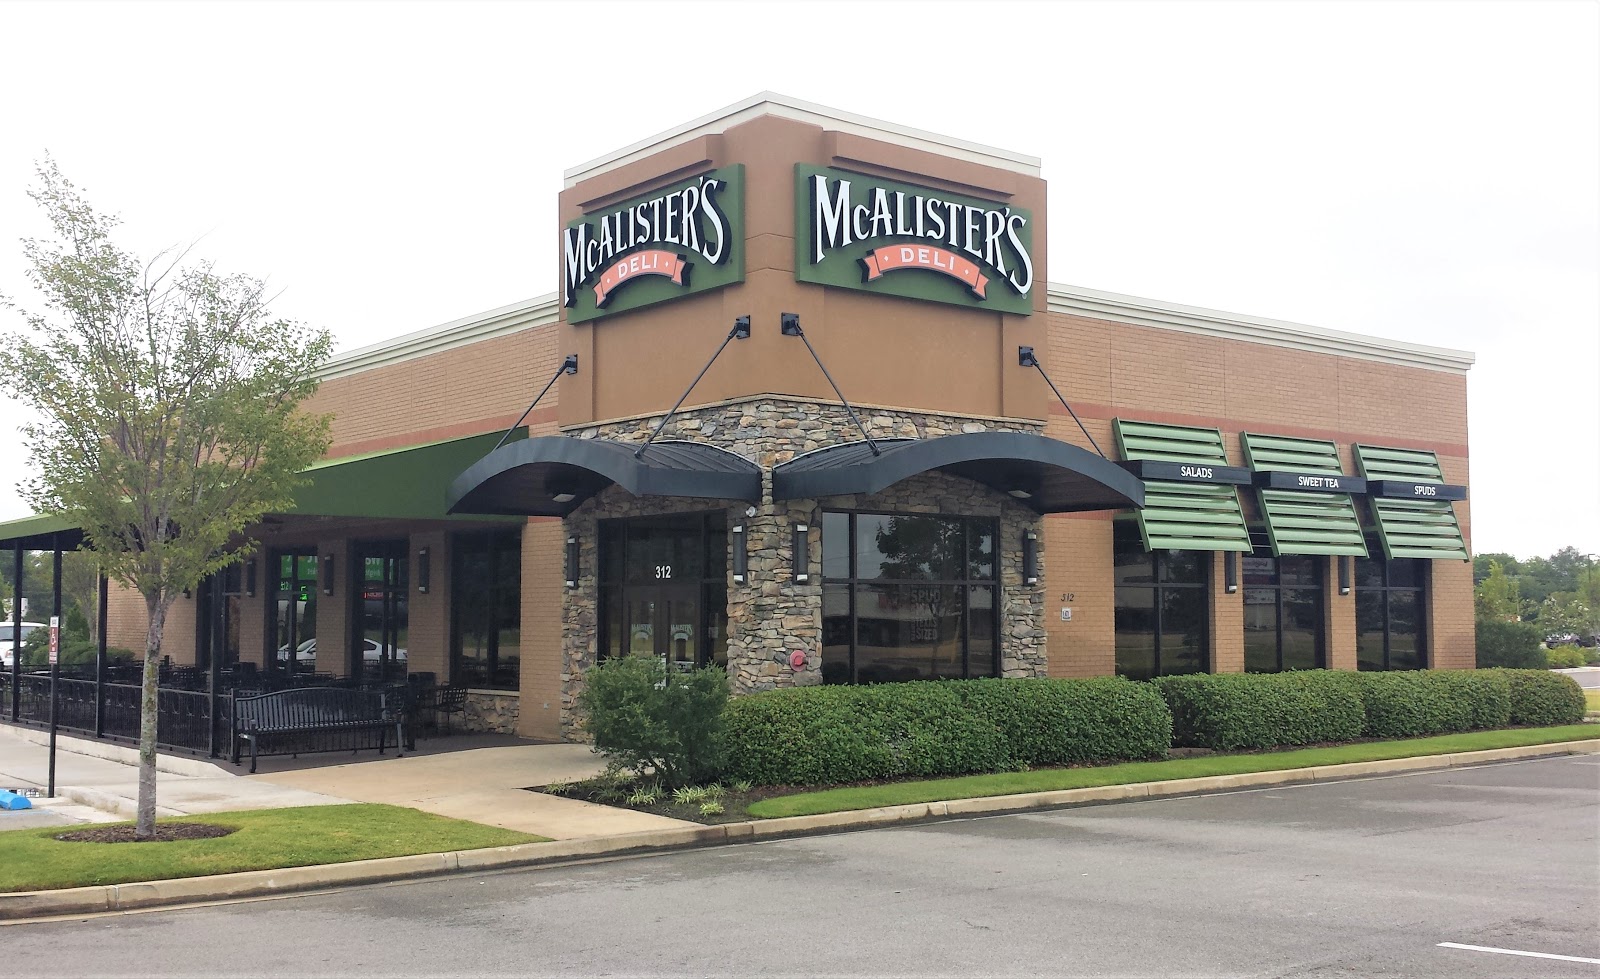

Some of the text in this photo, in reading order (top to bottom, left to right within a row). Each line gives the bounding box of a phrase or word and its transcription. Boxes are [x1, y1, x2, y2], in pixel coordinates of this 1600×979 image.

[563, 176, 727, 308] McALISTER'S
[813, 174, 1034, 295] McALISTER'S
[616, 256, 658, 280] DELI
[899, 247, 955, 271] DELI
[1180, 465, 1213, 479] SALADS
[1298, 475, 1340, 489] SWEET TEA
[1414, 485, 1436, 497] SPUDS
[655, 565, 672, 579] 312
